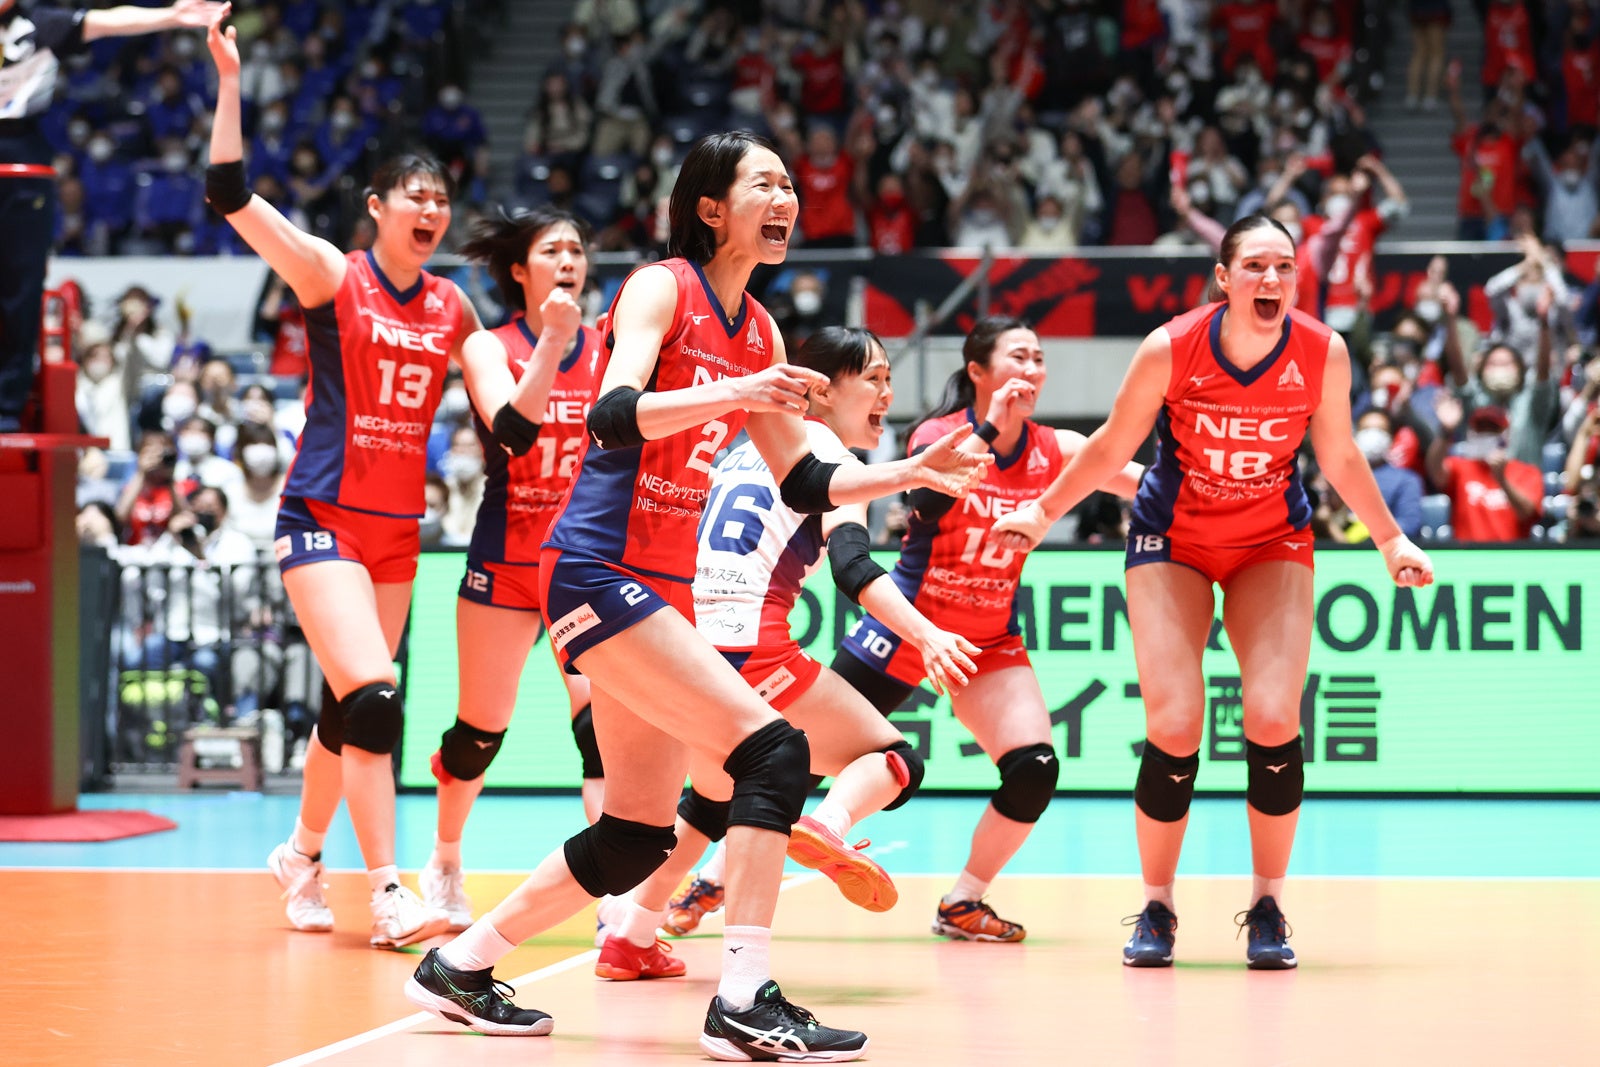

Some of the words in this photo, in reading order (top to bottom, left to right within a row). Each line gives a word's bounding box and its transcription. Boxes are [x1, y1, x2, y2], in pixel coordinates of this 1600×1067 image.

[372, 321, 446, 355] NEC
[683, 345, 730, 371] Orchestrating
[377, 359, 433, 409] 13
[543, 401, 590, 424] NE
[1183, 399, 1242, 414] Orchestrating
[1194, 413, 1289, 442] NEC
[537, 437, 583, 478] 12
[685, 419, 729, 474] 2
[1203, 448, 1273, 480] 18
[697, 483, 775, 556] 16
[302, 530, 333, 551] 13
[1135, 535, 1164, 553] 18
[465, 569, 489, 593] 12
[620, 582, 650, 606] 2
[1317, 584, 1582, 651] OMEN
[861, 629, 893, 659] 10
